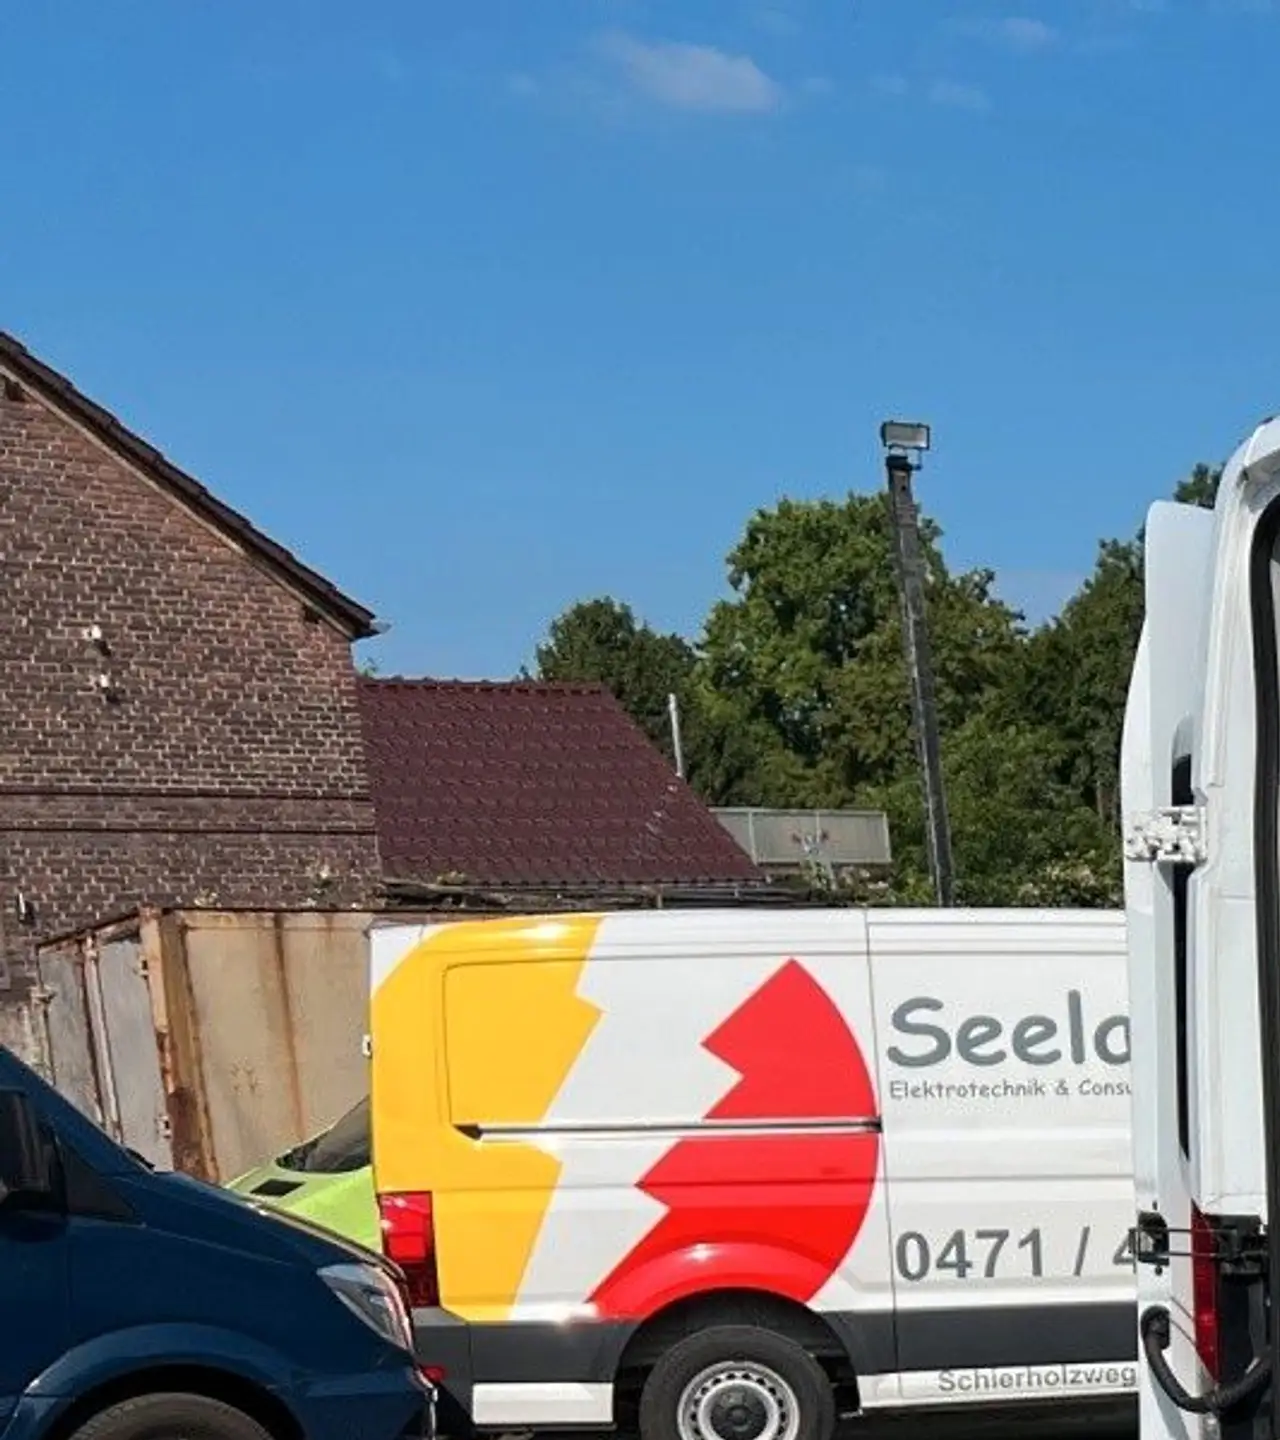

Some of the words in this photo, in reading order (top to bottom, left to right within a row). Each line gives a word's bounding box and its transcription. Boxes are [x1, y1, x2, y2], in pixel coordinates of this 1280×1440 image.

[889, 1080, 1047, 1100] Elektrotechnik
[1055, 1079, 1070, 1096] &
[896, 1226, 1043, 1281] 0471
[1073, 1226, 1090, 1277] /
[938, 1366, 1137, 1393] Schierholzweg
